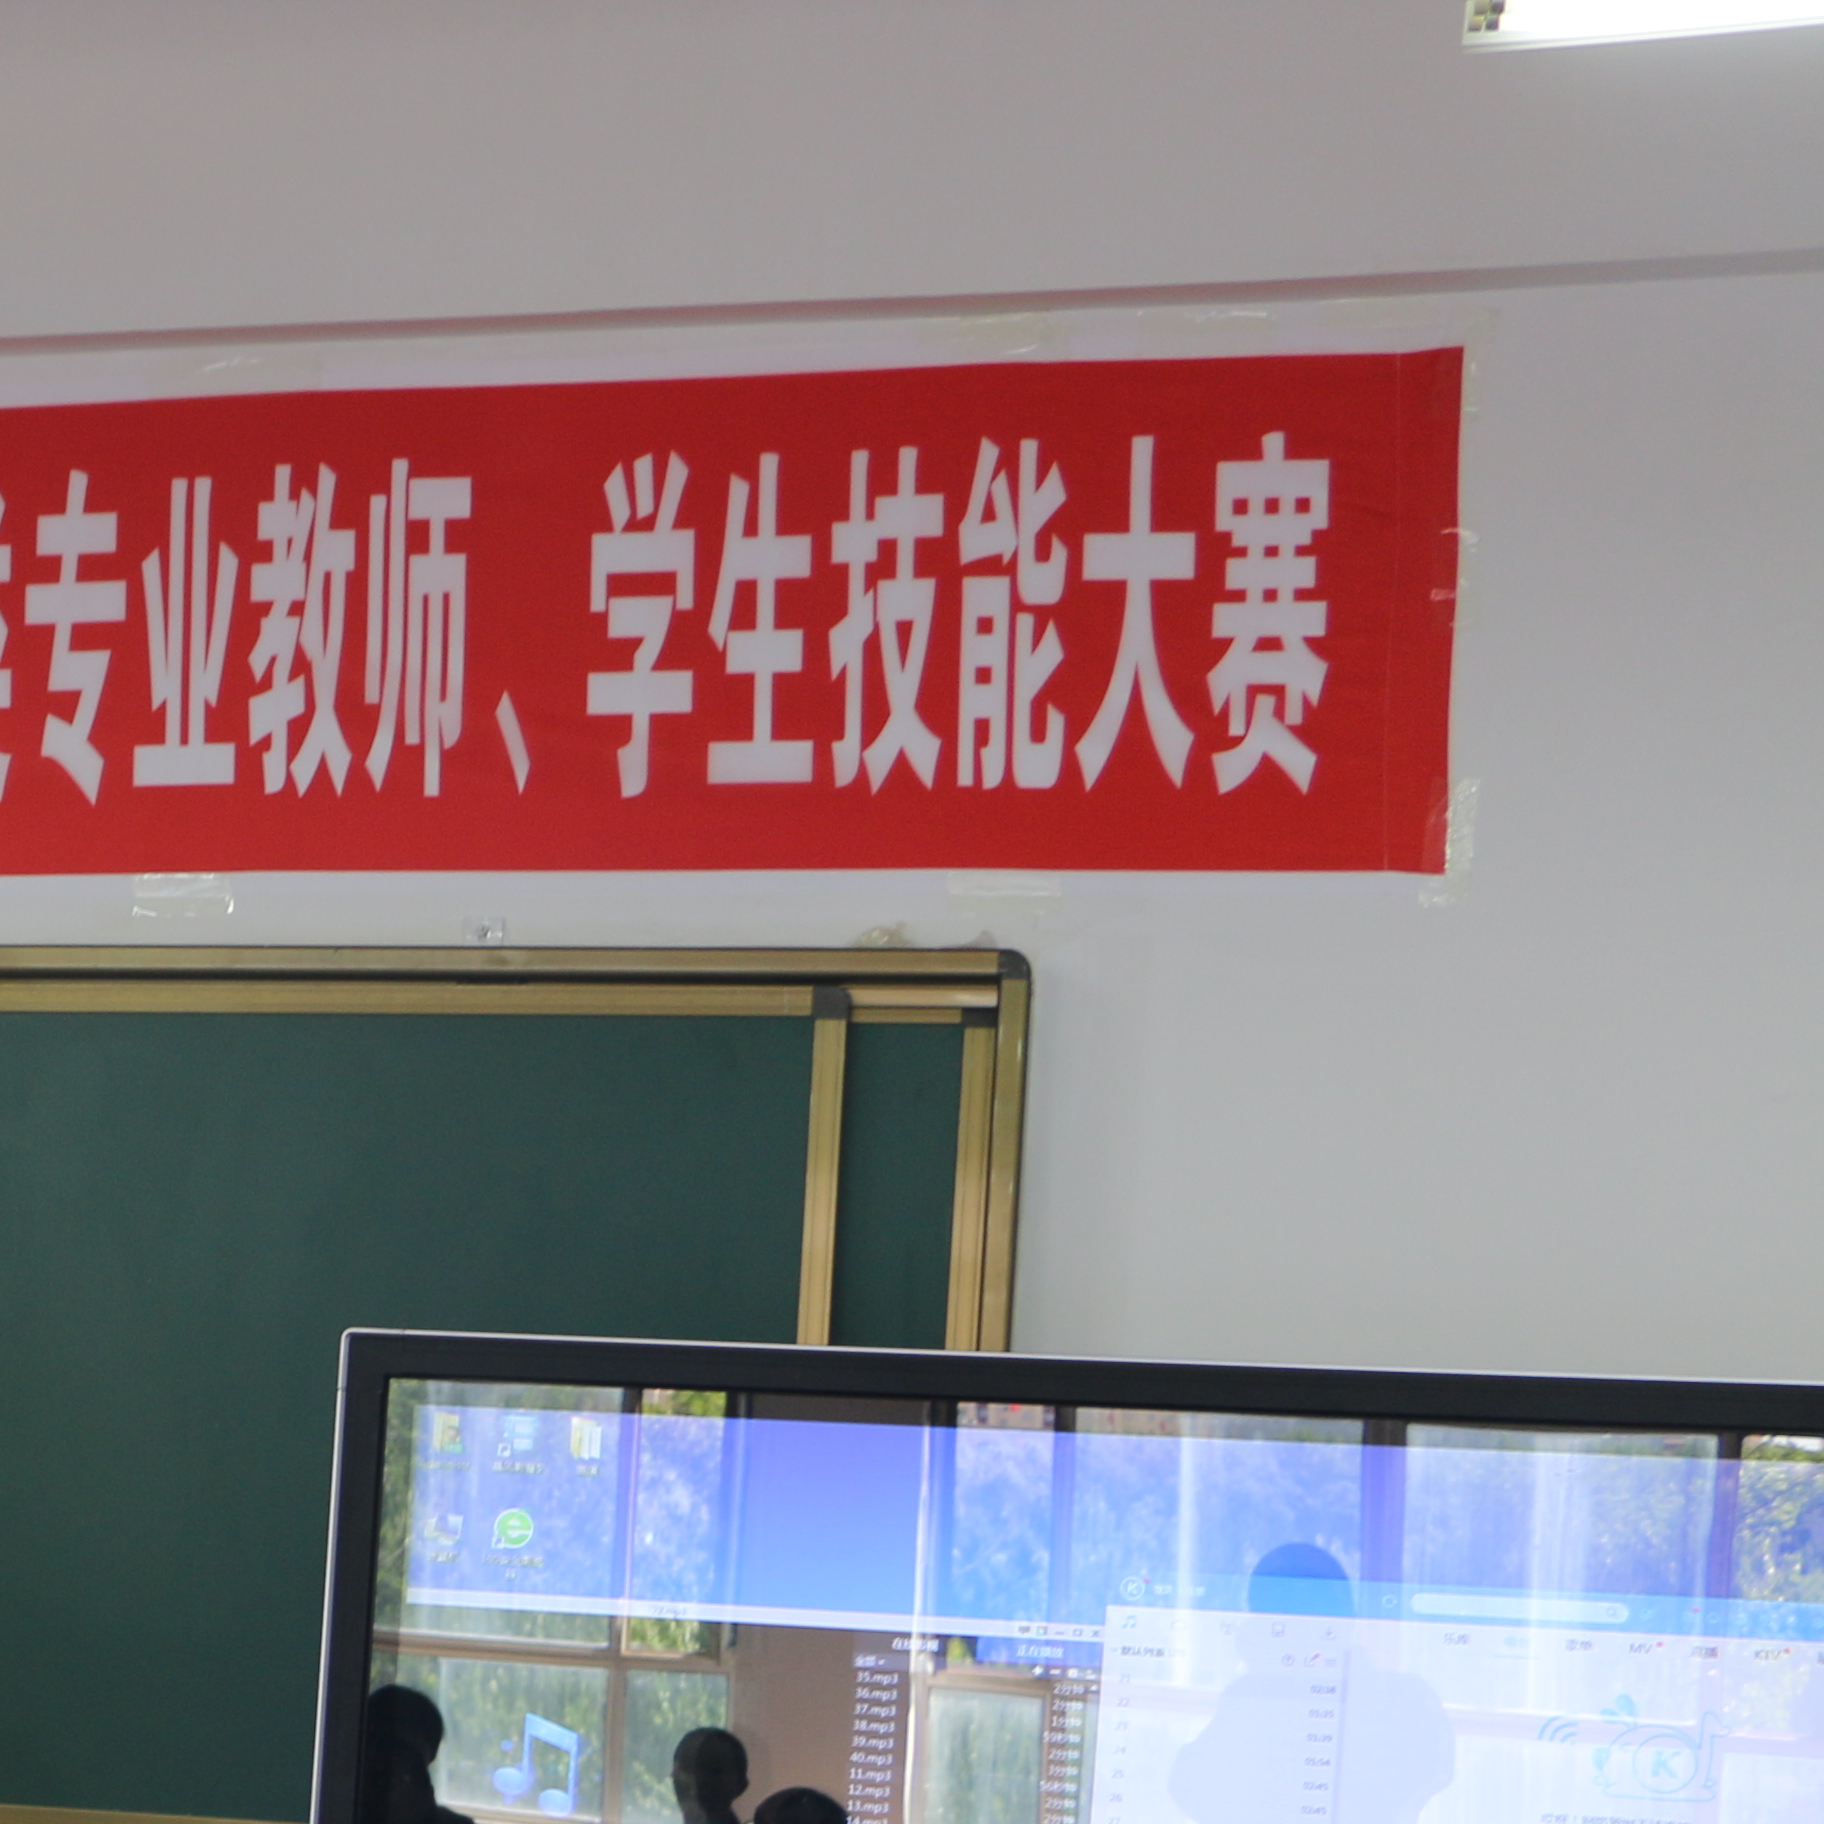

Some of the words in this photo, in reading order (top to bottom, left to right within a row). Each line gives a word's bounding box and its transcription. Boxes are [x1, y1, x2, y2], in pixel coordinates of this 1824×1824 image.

[1628, 1642, 1653, 1655] MV
[1754, 1650, 1782, 1661] KTV
[855, 1671, 899, 1686] 35.mp3
[855, 1687, 898, 1702] 36.mp3
[854, 1703, 897, 1718] 37.mp3
[853, 1719, 896, 1734] 38.mp3
[851, 1735, 894, 1750] 39.mp3
[849, 1751, 893, 1766] 40.mp3
[849, 1768, 892, 1782] 11.mp3
[848, 1784, 890, 1798] 12.mp3
[847, 1800, 889, 1815] 13.mp3
